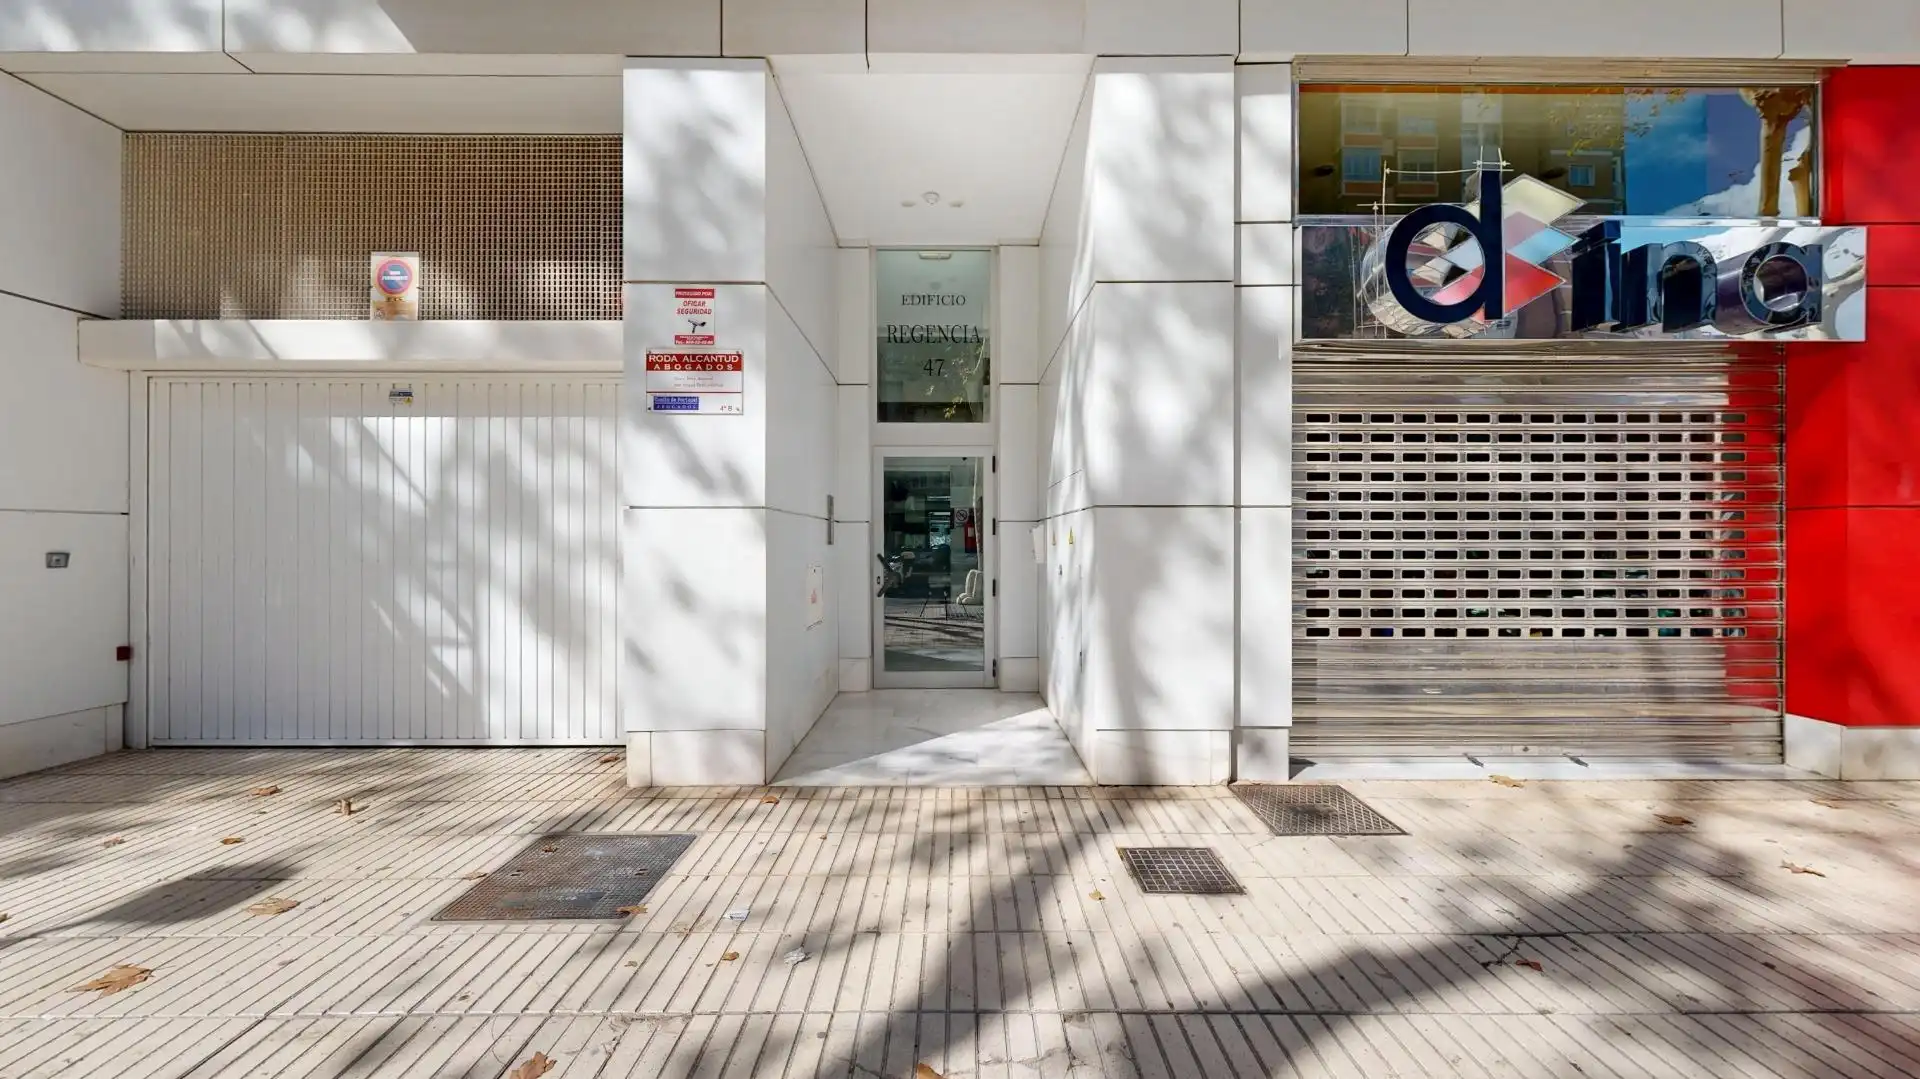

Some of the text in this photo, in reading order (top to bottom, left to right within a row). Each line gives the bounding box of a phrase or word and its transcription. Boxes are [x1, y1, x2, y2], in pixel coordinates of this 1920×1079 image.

[902, 294, 966, 306] EDIFICIO
[887, 325, 981, 344] REGENCIA
[648, 354, 739, 363] RODA ALCANTUD
[653, 363, 733, 371] ABOGADOS
[923, 359, 945, 376] 47
